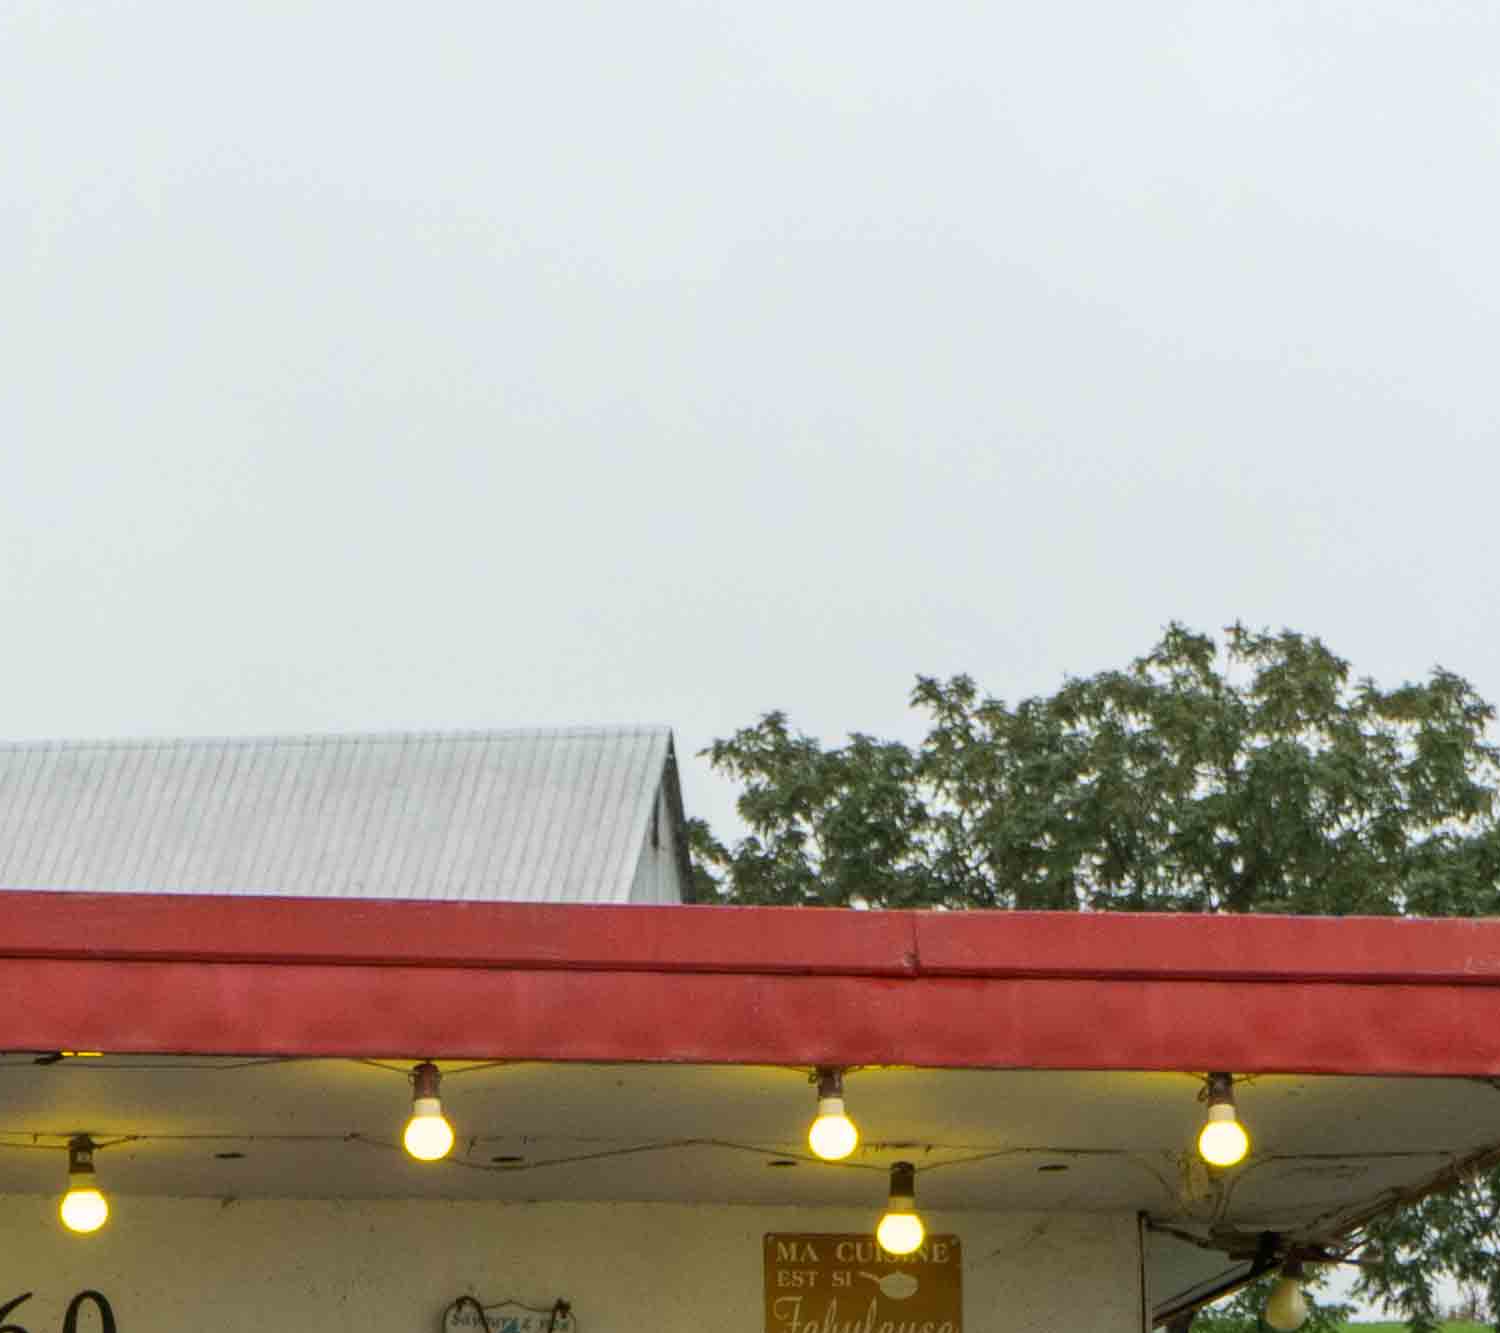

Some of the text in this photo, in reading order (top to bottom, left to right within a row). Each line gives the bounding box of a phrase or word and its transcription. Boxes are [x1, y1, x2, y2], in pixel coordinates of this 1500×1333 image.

[776, 1242, 819, 1263] MA
[777, 1271, 851, 1287] EST SI
